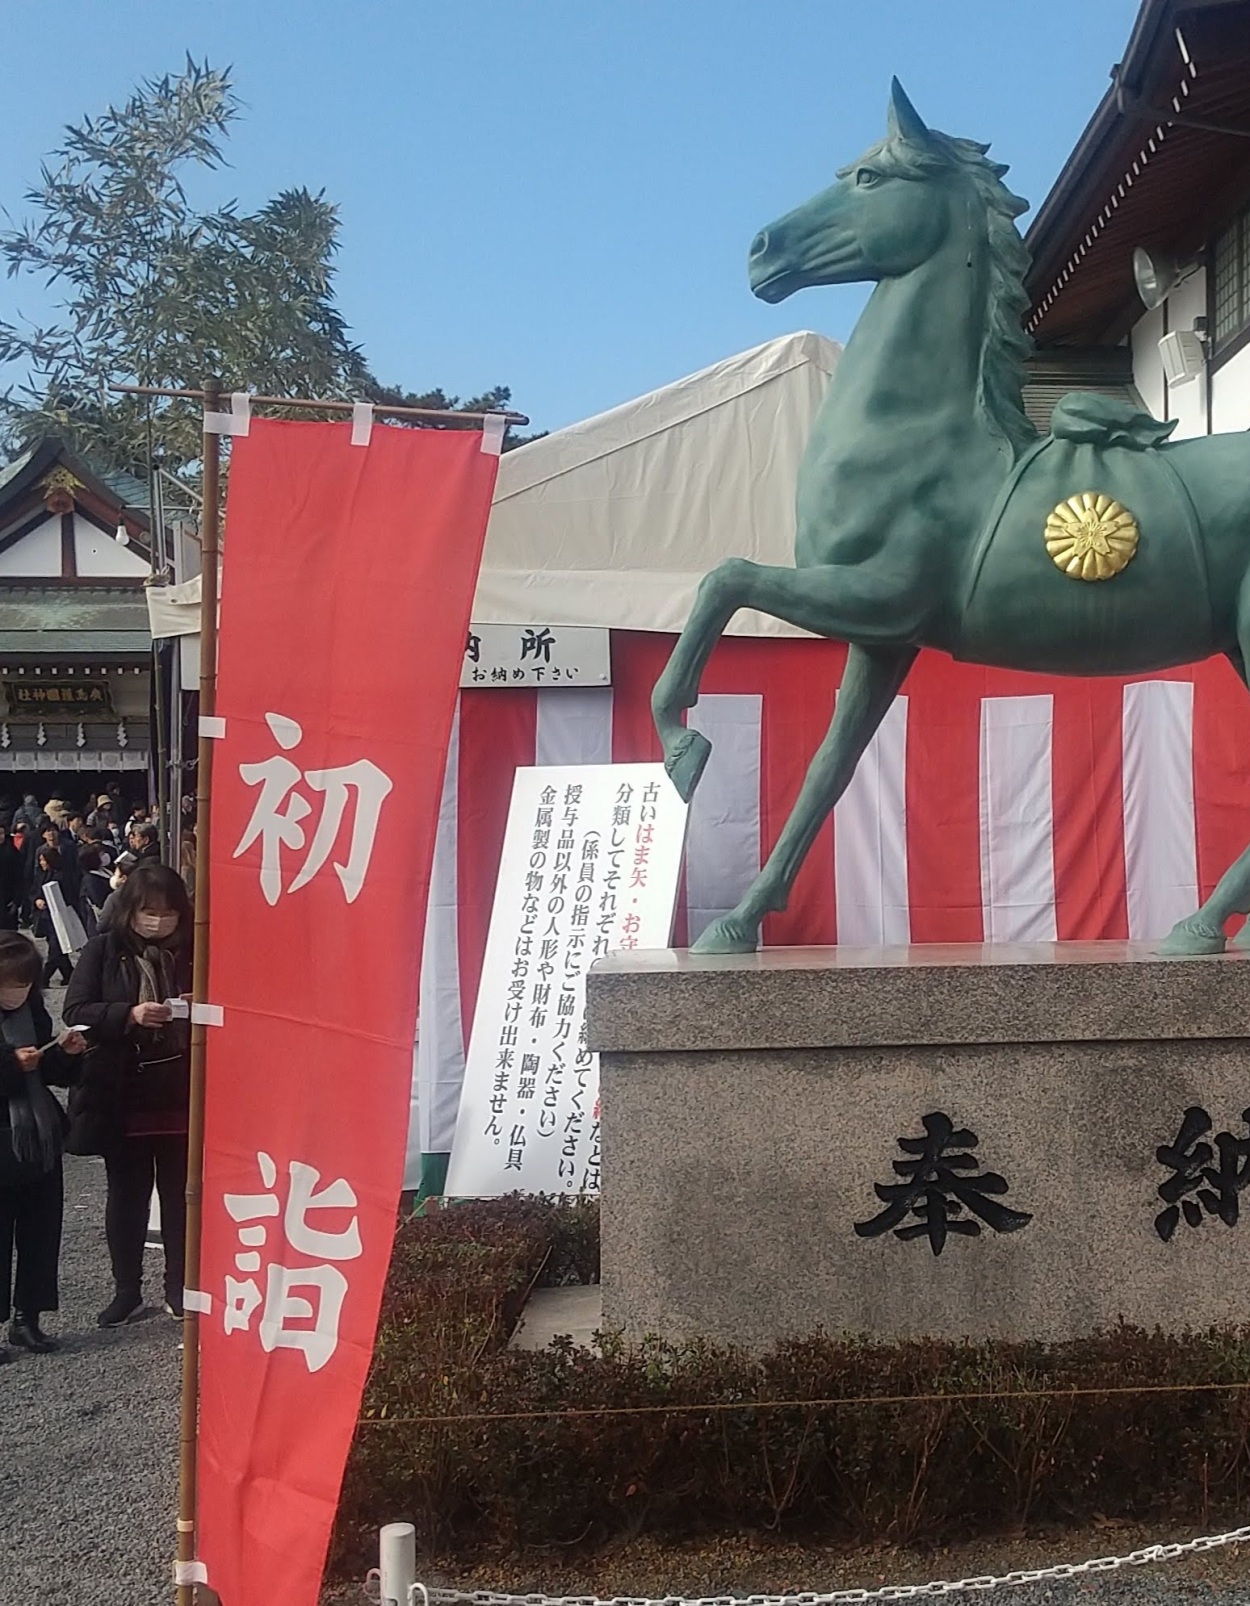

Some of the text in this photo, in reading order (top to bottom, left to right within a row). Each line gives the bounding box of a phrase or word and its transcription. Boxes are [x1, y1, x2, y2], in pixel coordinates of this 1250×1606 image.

[472, 666, 579, 682] お納め下さい
[223, 711, 393, 1373] 初詣
[484, 785, 557, 1145] 金属製の物などはお受け出来ません。
[504, 784, 583, 1171] 授与品以外の人形や財布・陶器・仏具
[558, 1006, 593, 1188] めてください。
